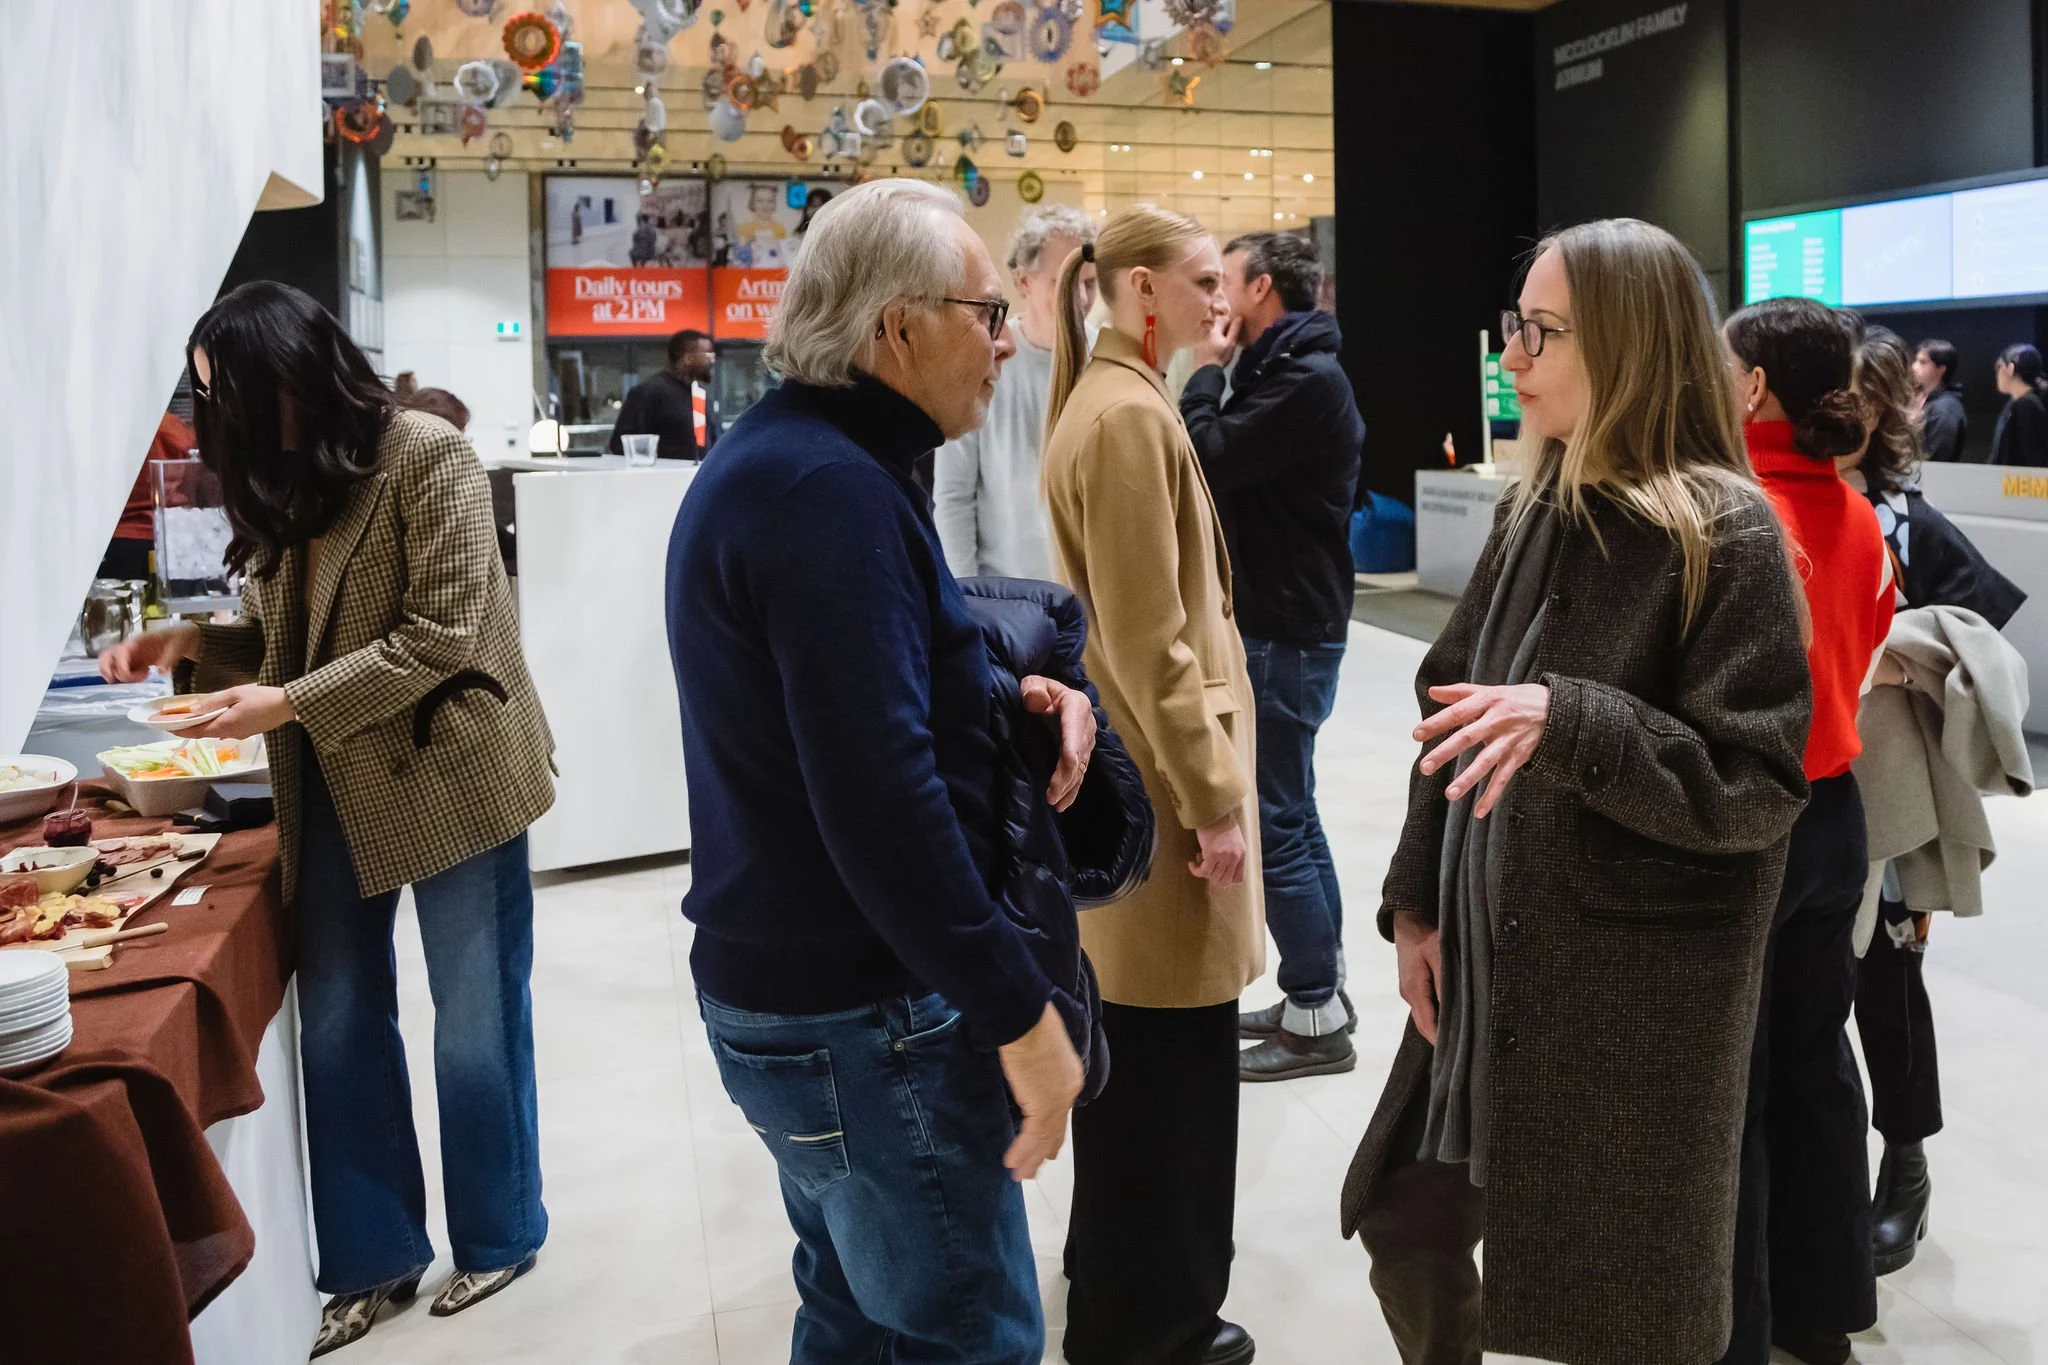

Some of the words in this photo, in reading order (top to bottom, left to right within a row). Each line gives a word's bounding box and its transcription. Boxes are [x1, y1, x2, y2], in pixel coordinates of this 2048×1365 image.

[1636, 3, 1688, 38] FAMILY
[575, 275, 627, 299] Daily
[630, 278, 683, 298] tours
[592, 302, 612, 321] at
[726, 303, 753, 321] on
